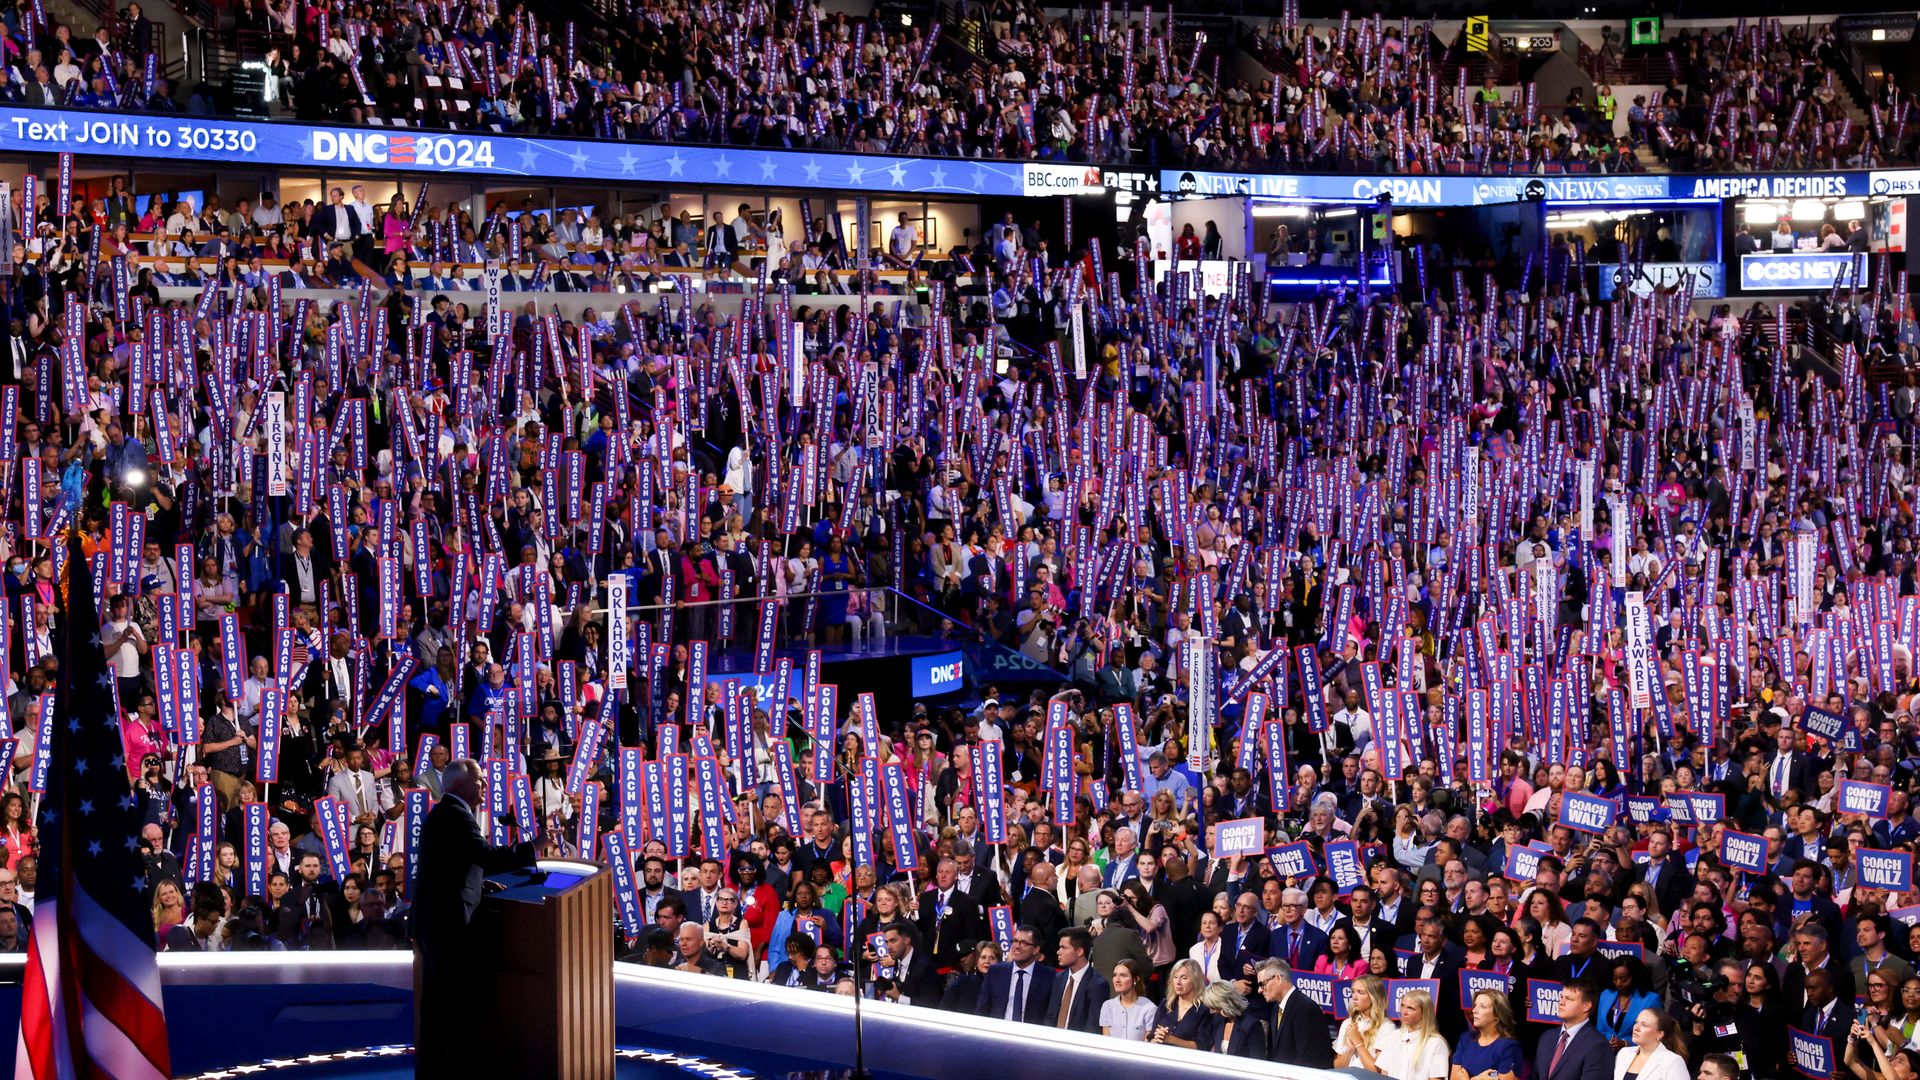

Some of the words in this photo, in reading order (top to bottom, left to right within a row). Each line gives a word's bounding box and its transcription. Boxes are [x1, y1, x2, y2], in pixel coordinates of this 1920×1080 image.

[1532, 38, 1551, 47] 205
[11, 117, 69, 141] Text
[75, 121, 139, 145] JOIN
[146, 126, 172, 148] to
[178, 127, 256, 151] 30330
[313, 130, 388, 164] DNC
[416, 138, 496, 168] 2024
[1028, 172, 1079, 187] BBC.com
[1180, 179, 1196, 190] abc
[1251, 178, 1298, 196] LIVE
[1546, 181, 1609, 200] NEWS
[1626, 184, 1662, 196] NEWS
[1694, 178, 1771, 198] AMERICA
[1773, 176, 1847, 197] DECIDES
[1762, 262, 1800, 280] CBS
[488, 268, 497, 334] WYOMING
[398, 389, 412, 423] COACH
[408, 426, 419, 454] WALZ
[868, 371, 877, 436] NEVADA
[154, 391, 166, 428] COACH
[160, 431, 171, 460] WALZ
[272, 403, 282, 481] VIRGINIA
[1743, 408, 1753, 459] TEXAS
[850, 468, 860, 498] COACH
[843, 501, 854, 528] WALZ
[131, 515, 140, 556] COACH
[417, 523, 425, 560] COACH
[94, 553, 104, 593] COACH
[128, 562, 138, 592] WALZ
[419, 563, 428, 593] WALZ
[182, 593, 190, 626] WALZ
[226, 616, 235, 659] COACH
[612, 587, 623, 673] OKLAHOMA
[1467, 630, 1475, 668] COACH
[1631, 606, 1645, 691] DELAWARE
[1880, 624, 1888, 659] COACH
[159, 646, 169, 689] COACH
[181, 651, 191, 698] COACH
[228, 663, 238, 697] WALZ
[693, 643, 702, 684] COACH
[930, 664, 954, 684] DNC
[1685, 653, 1697, 693] COACH
[1882, 663, 1891, 691] WALZ
[523, 681, 532, 713] WALZ
[691, 688, 701, 721] WALZ
[1302, 648, 1316, 690] COACH
[1309, 695, 1322, 729] WALZ
[1553, 682, 1561, 725] COACH
[1648, 662, 1662, 701] COACH
[1657, 705, 1670, 735] WALZ
[162, 694, 172, 728] WALZ
[182, 703, 193, 740] WALZ
[267, 691, 275, 736] COACH
[807, 697, 816, 728] WALZ
[822, 687, 831, 735] COACH
[1248, 695, 1260, 739] COACH
[1385, 691, 1394, 736] COACH
[1472, 692, 1481, 738] COACH
[1612, 691, 1622, 731] COACH
[1689, 696, 1699, 728] WALZ
[1807, 720, 1838, 738] WALZ
[1809, 711, 1843, 729] COACH
[263, 742, 274, 778] WALZ
[819, 740, 830, 778] WALZ
[1058, 730, 1068, 777] COACH
[1270, 723, 1280, 767] COACH
[1386, 740, 1397, 776] WALZ
[1436, 727, 1448, 777] COACH
[1472, 742, 1483, 778] WALZ
[1615, 735, 1624, 768] WALZ
[36, 749, 51, 788] WALZ
[493, 762, 502, 812] COACH
[627, 751, 635, 801] COACH
[673, 756, 682, 808] COACH
[702, 760, 715, 812] COACH
[987, 744, 997, 793] COACH
[516, 779, 530, 827] COACH
[649, 763, 662, 813] COACH
[852, 779, 863, 827] COACH
[888, 767, 903, 818] COACH
[1058, 782, 1069, 821] WALZ
[1274, 772, 1284, 808] WALZ
[1628, 800, 1654, 812] COACH
[1845, 798, 1880, 812] WALZ
[1846, 786, 1882, 800] COACH
[204, 786, 212, 836] COACH
[321, 800, 340, 849] COACH
[626, 806, 637, 846] WALZ
[988, 799, 1000, 839] WALZ
[1568, 808, 1605, 829] WALZ
[1569, 798, 1608, 819] COACH
[251, 806, 260, 856] COACH
[673, 813, 685, 854] WALZ
[706, 816, 719, 858] WALZ
[895, 824, 911, 865] WALZ
[1221, 825, 1256, 838] COACH
[1222, 835, 1256, 851] WALZ
[1727, 836, 1760, 854] COACH
[202, 841, 213, 882] WALZ
[1271, 849, 1303, 864] COACH
[1275, 860, 1308, 876] WALZ
[1331, 850, 1346, 888] COACH
[1340, 849, 1358, 887] WALZ
[1726, 848, 1758, 867] WALZ
[1862, 856, 1902, 871] COACH
[608, 835, 627, 887] COACH
[621, 891, 638, 934] WALZ
[1863, 868, 1902, 885] WALZ
[996, 909, 1009, 961] COACH
[1297, 978, 1331, 992] COACH
[1469, 977, 1504, 991] COACH
[1794, 1037, 1823, 1055] COACH
[1796, 1052, 1826, 1073] WALZ
